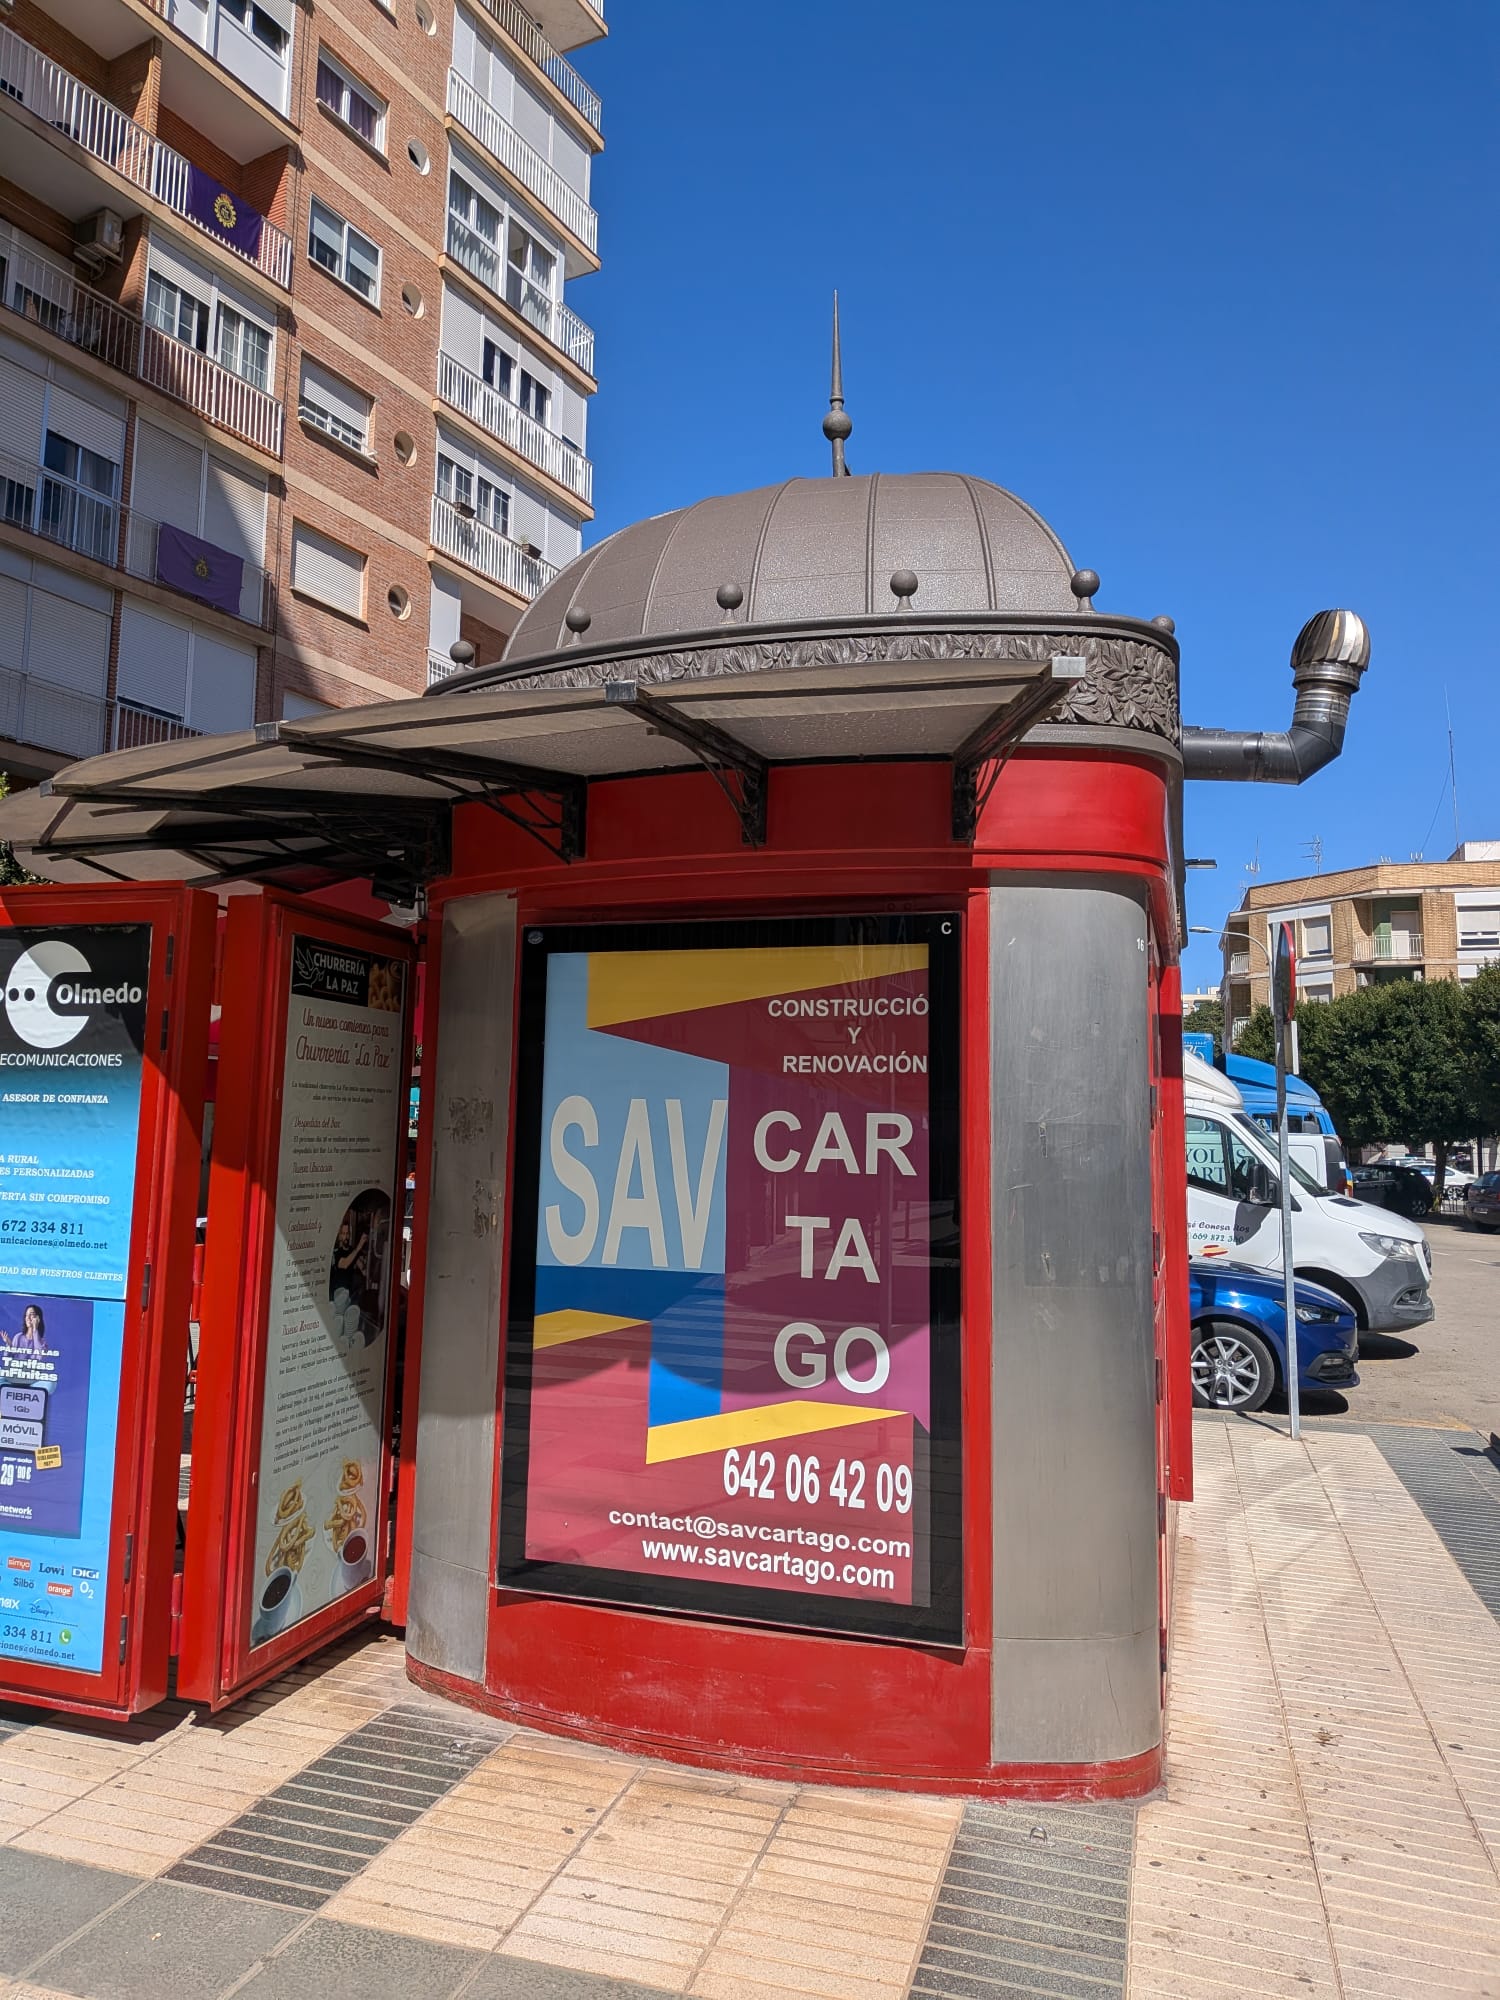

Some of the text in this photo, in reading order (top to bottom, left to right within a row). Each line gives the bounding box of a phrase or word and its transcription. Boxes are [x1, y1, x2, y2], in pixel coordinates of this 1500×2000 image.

[1136, 937, 1145, 952] 16
[313, 952, 366, 977] CHURRERÍA
[56, 982, 142, 1005] Olmedo
[326, 976, 359, 995] LA PAZ
[767, 994, 929, 1018] CONSTRUCCIÓ
[315, 1015, 338, 1029] nuevo
[847, 1027, 862, 1044] Y
[296, 1035, 350, 1065] Churrería
[783, 1050, 928, 1074] RENOVACIÓN
[2, 1093, 109, 1104] ASESOR DE CONFIANZA
[753, 1110, 918, 1176] CAR
[7, 1155, 39, 1164] RURAL
[13, 1168, 94, 1178] PERSONALIZADAS
[545, 1095, 729, 1269] SAV
[29, 1193, 45, 1202] SIN
[47, 1194, 110, 1205] COMPROMISO
[1, 1219, 84, 1235] 672 334 811
[785, 1215, 880, 1284] TA
[21, 1267, 38, 1276] SON
[40, 1268, 82, 1279] NUESTROS
[84, 1271, 123, 1281] CLIENTES
[41, 1349, 60, 1357] LAS
[773, 1322, 890, 1394] GO
[2, 1356, 55, 1371] Tarifas
[6, 1391, 40, 1403] FIBRA
[2, 1424, 38, 1436] MÓVIL
[0, 1436, 14, 1445] GB
[723, 1448, 913, 1514] 642 06 42 09
[608, 1508, 911, 1558] contact@savcartago.com
[8, 1558, 100, 1579] simyo Lowi DIGI
[641, 1538, 895, 1590] www.savcartago.com
[48, 1585, 71, 1596] orange
[3, 1624, 52, 1644] 334 811
